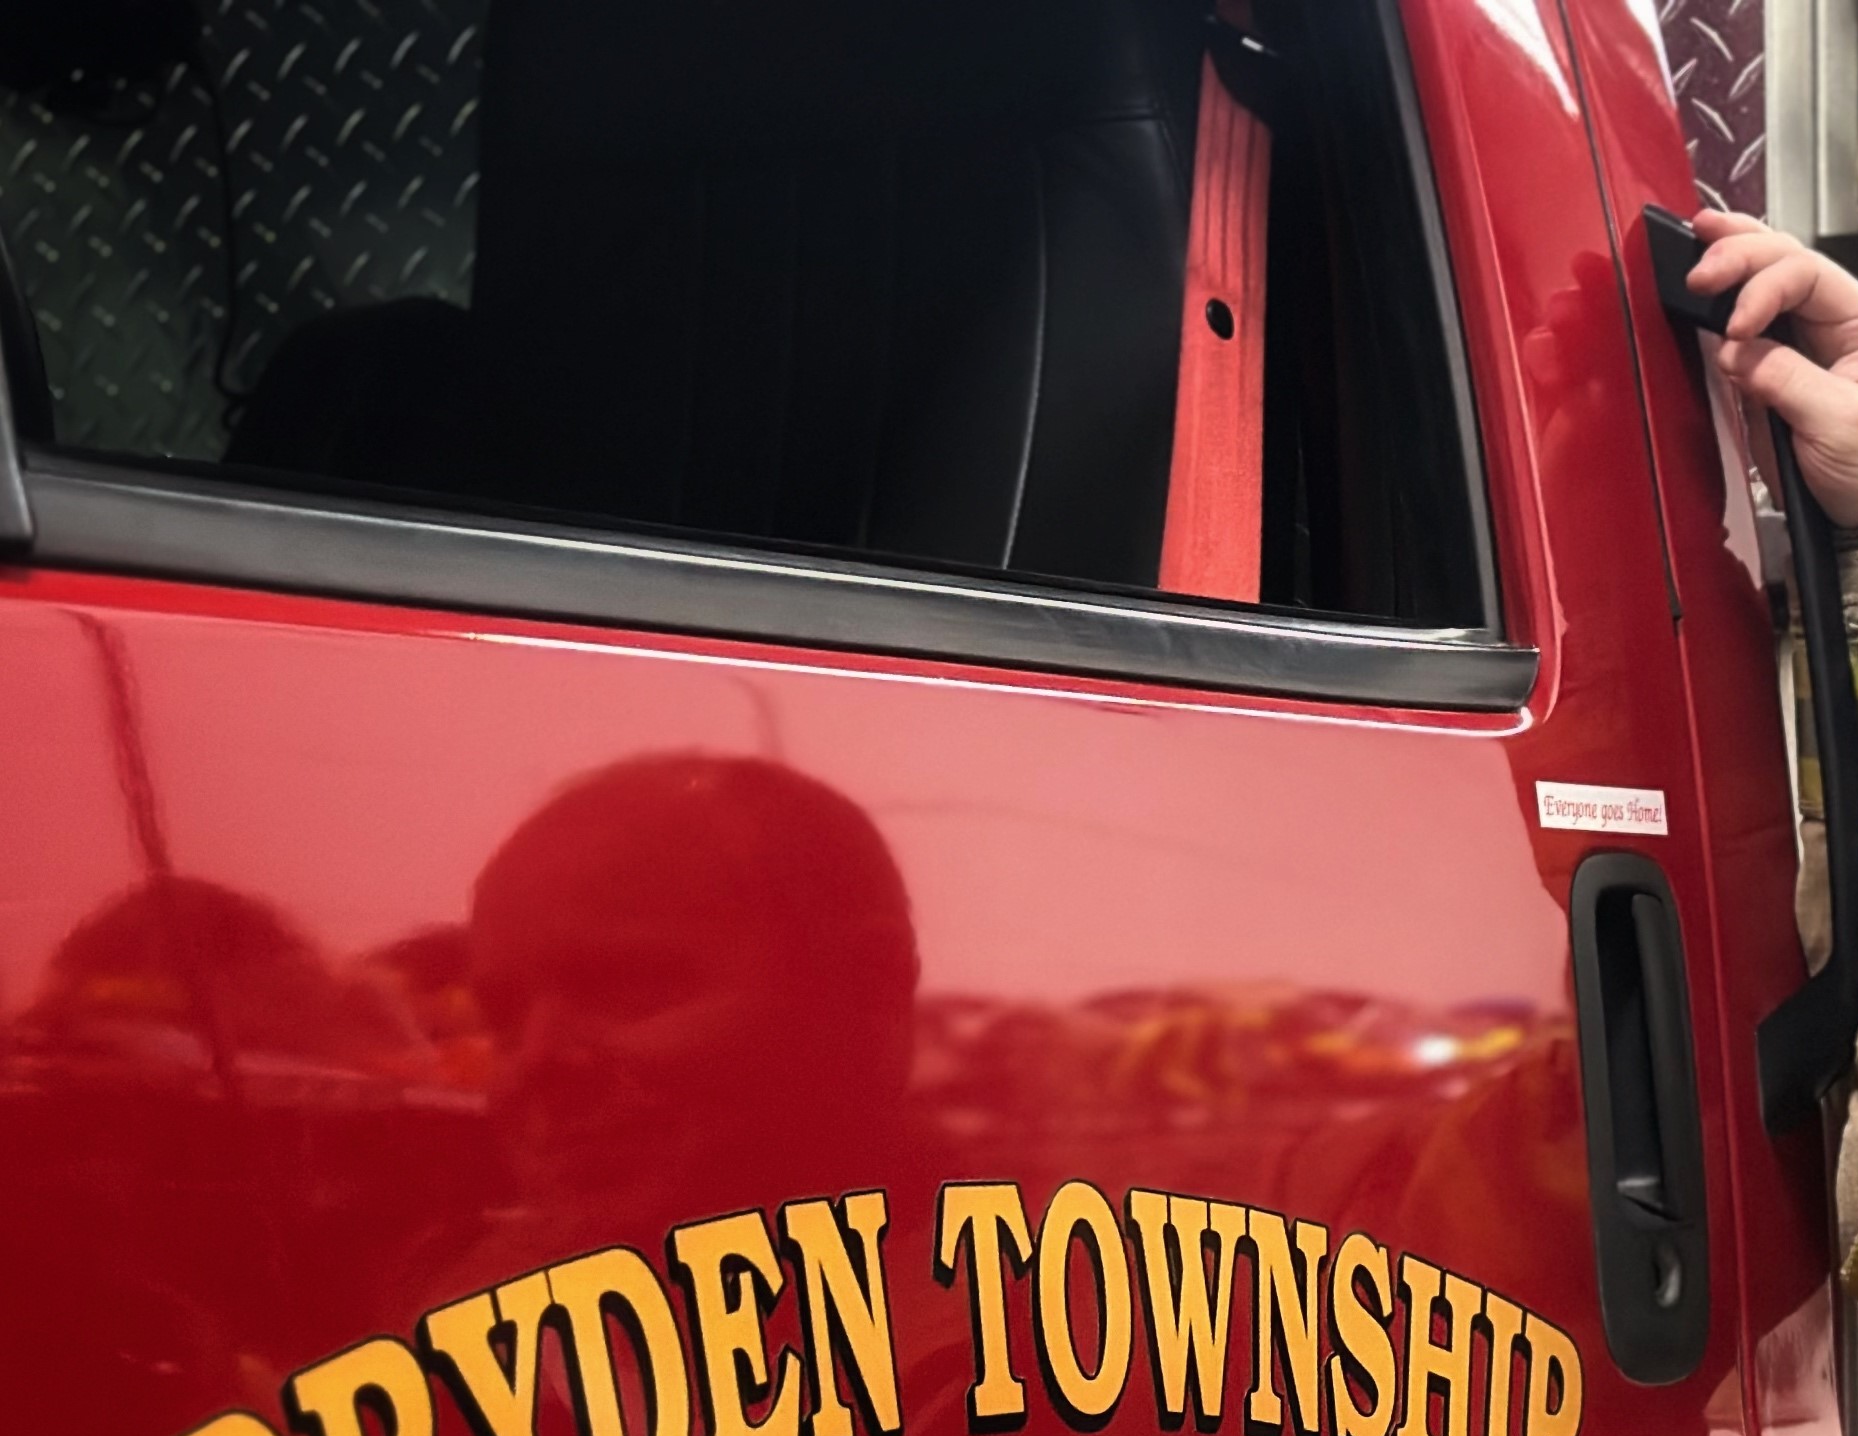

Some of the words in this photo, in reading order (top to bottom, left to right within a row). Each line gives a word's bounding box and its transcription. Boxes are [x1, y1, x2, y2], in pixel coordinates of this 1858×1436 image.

[1543, 795, 1598, 826] Everyone
[1601, 803, 1624, 828] goes
[1627, 797, 1662, 823] Home!
